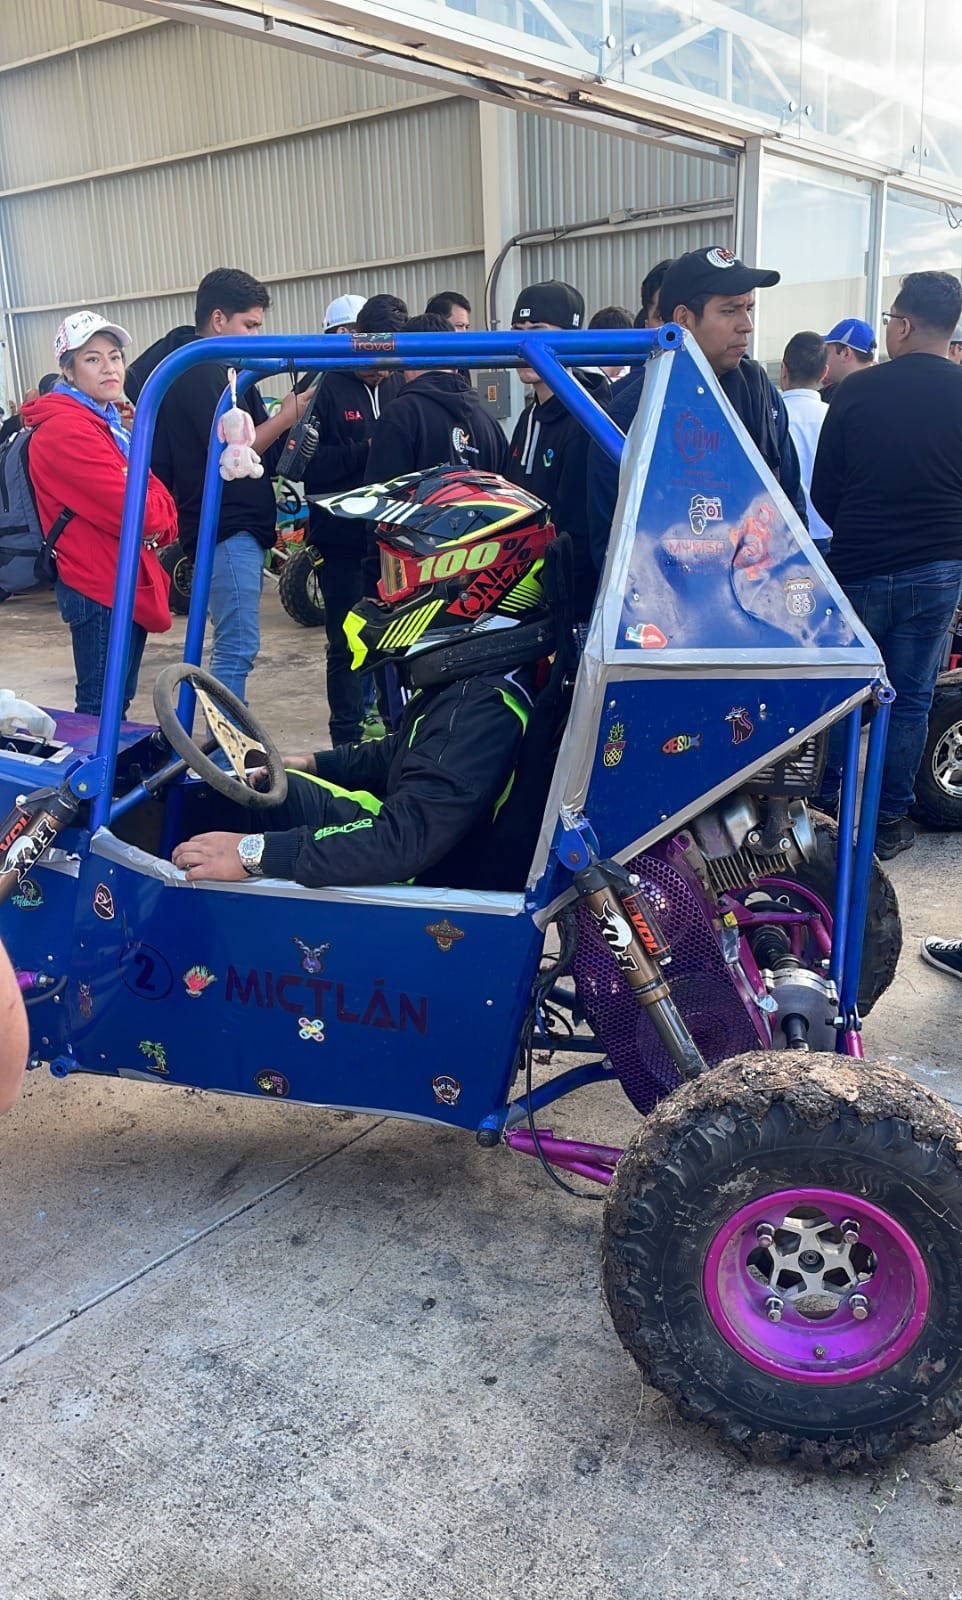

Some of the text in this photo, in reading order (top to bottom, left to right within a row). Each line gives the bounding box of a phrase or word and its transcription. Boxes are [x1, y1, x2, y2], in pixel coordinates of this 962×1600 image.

[352, 339, 395, 351] Travel
[344, 410, 363, 420] ISA
[417, 534, 532, 583] 100%
[134, 952, 156, 992] 2
[225, 964, 428, 1035] MICTLÁN
